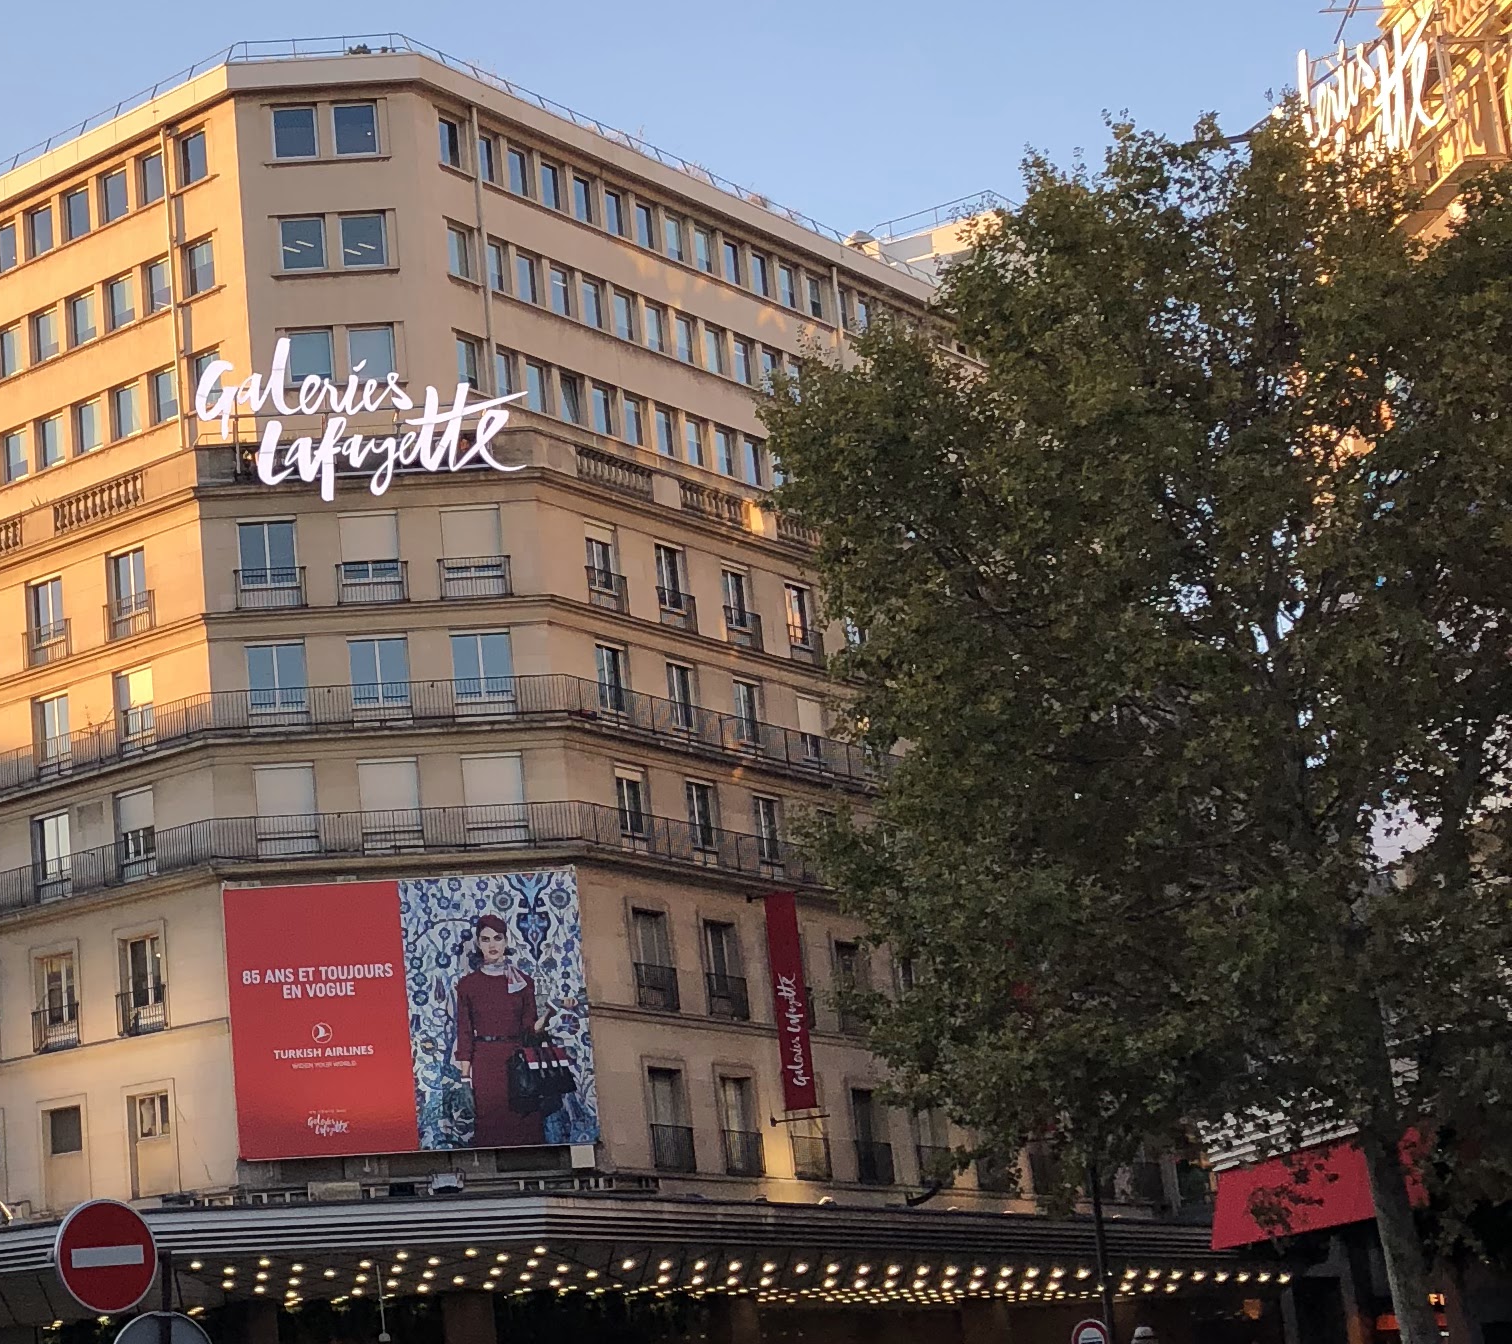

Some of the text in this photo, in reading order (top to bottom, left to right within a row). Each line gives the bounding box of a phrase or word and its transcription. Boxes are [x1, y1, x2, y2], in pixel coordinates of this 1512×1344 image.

[194, 337, 413, 440] Galeries
[256, 382, 529, 501] Lafayette
[242, 963, 394, 985] 85 ANS ET TOUJOURS
[282, 981, 356, 999] EN VOGUE
[273, 1045, 375, 1060] TURKISH AIRLINES
